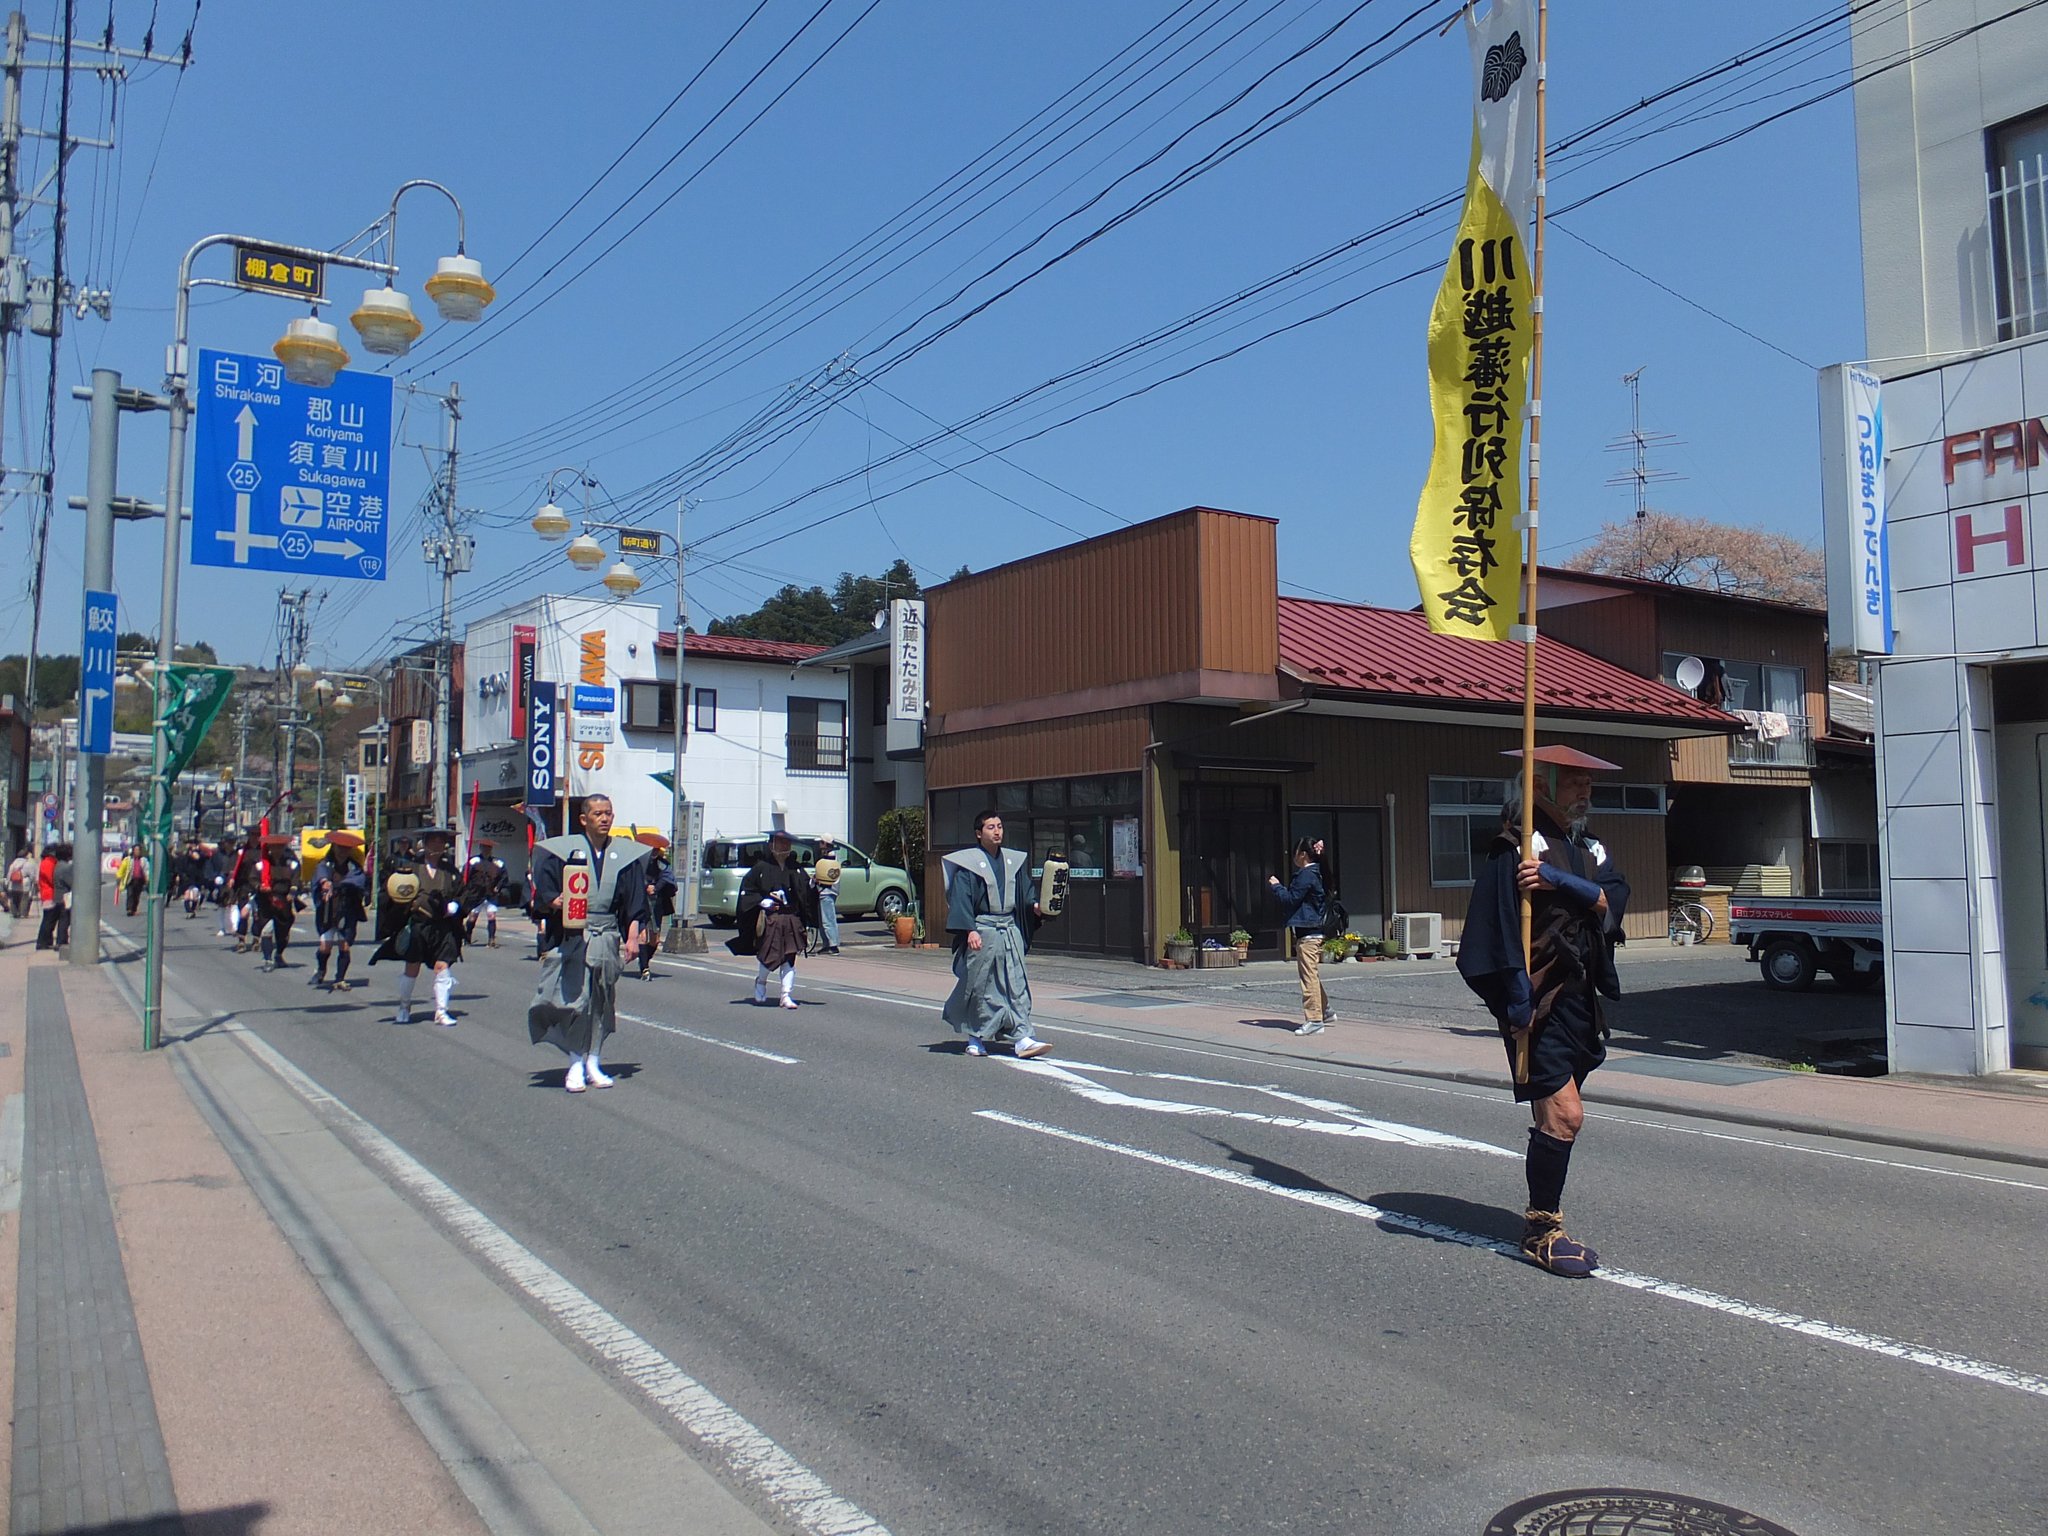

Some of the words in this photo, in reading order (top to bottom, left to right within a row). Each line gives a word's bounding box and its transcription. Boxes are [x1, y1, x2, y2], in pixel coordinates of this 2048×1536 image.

[246, 257, 314, 287] 棚倉町
[215, 358, 282, 390] 白河
[1849, 370, 1879, 390] HITACHI
[215, 384, 281, 406] Shirakawa
[307, 397, 364, 428] 郡山
[306, 425, 363, 443] Koriyama
[289, 440, 378, 474] 須賀川
[235, 470, 254, 484] 25
[299, 469, 366, 488] Sukagawa
[326, 490, 383, 520] 空港
[327, 517, 380, 534] AIRPORT
[286, 538, 306, 552] 25
[363, 560, 377, 571] 118
[86, 605, 114, 674] 鮫川
[901, 607, 918, 713] 近藤たたみ店
[577, 694, 613, 704] Panasonic
[532, 697, 550, 790] SONY
